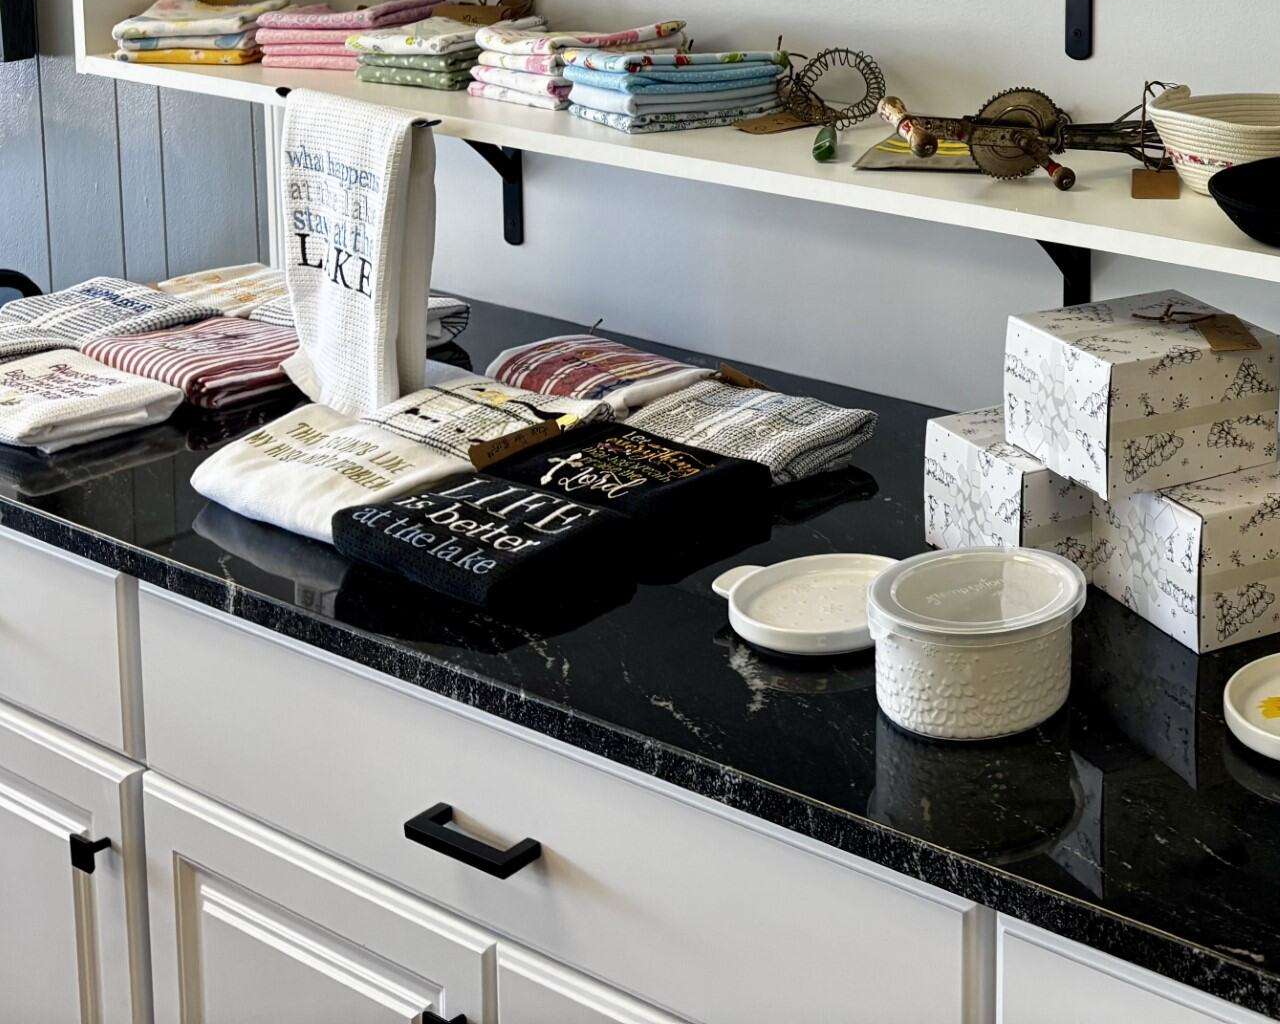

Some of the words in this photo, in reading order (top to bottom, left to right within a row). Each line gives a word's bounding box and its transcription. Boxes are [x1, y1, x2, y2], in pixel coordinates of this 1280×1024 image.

[291, 180, 312, 202] at
[350, 222, 373, 258] th
[369, 450, 415, 473] LIKE
[392, 494, 434, 510] is
[425, 502, 541, 552] better
[427, 477, 600, 534] LIFE
[352, 507, 392, 527] at
[384, 516, 436, 548] the
[427, 535, 497, 575] lake
